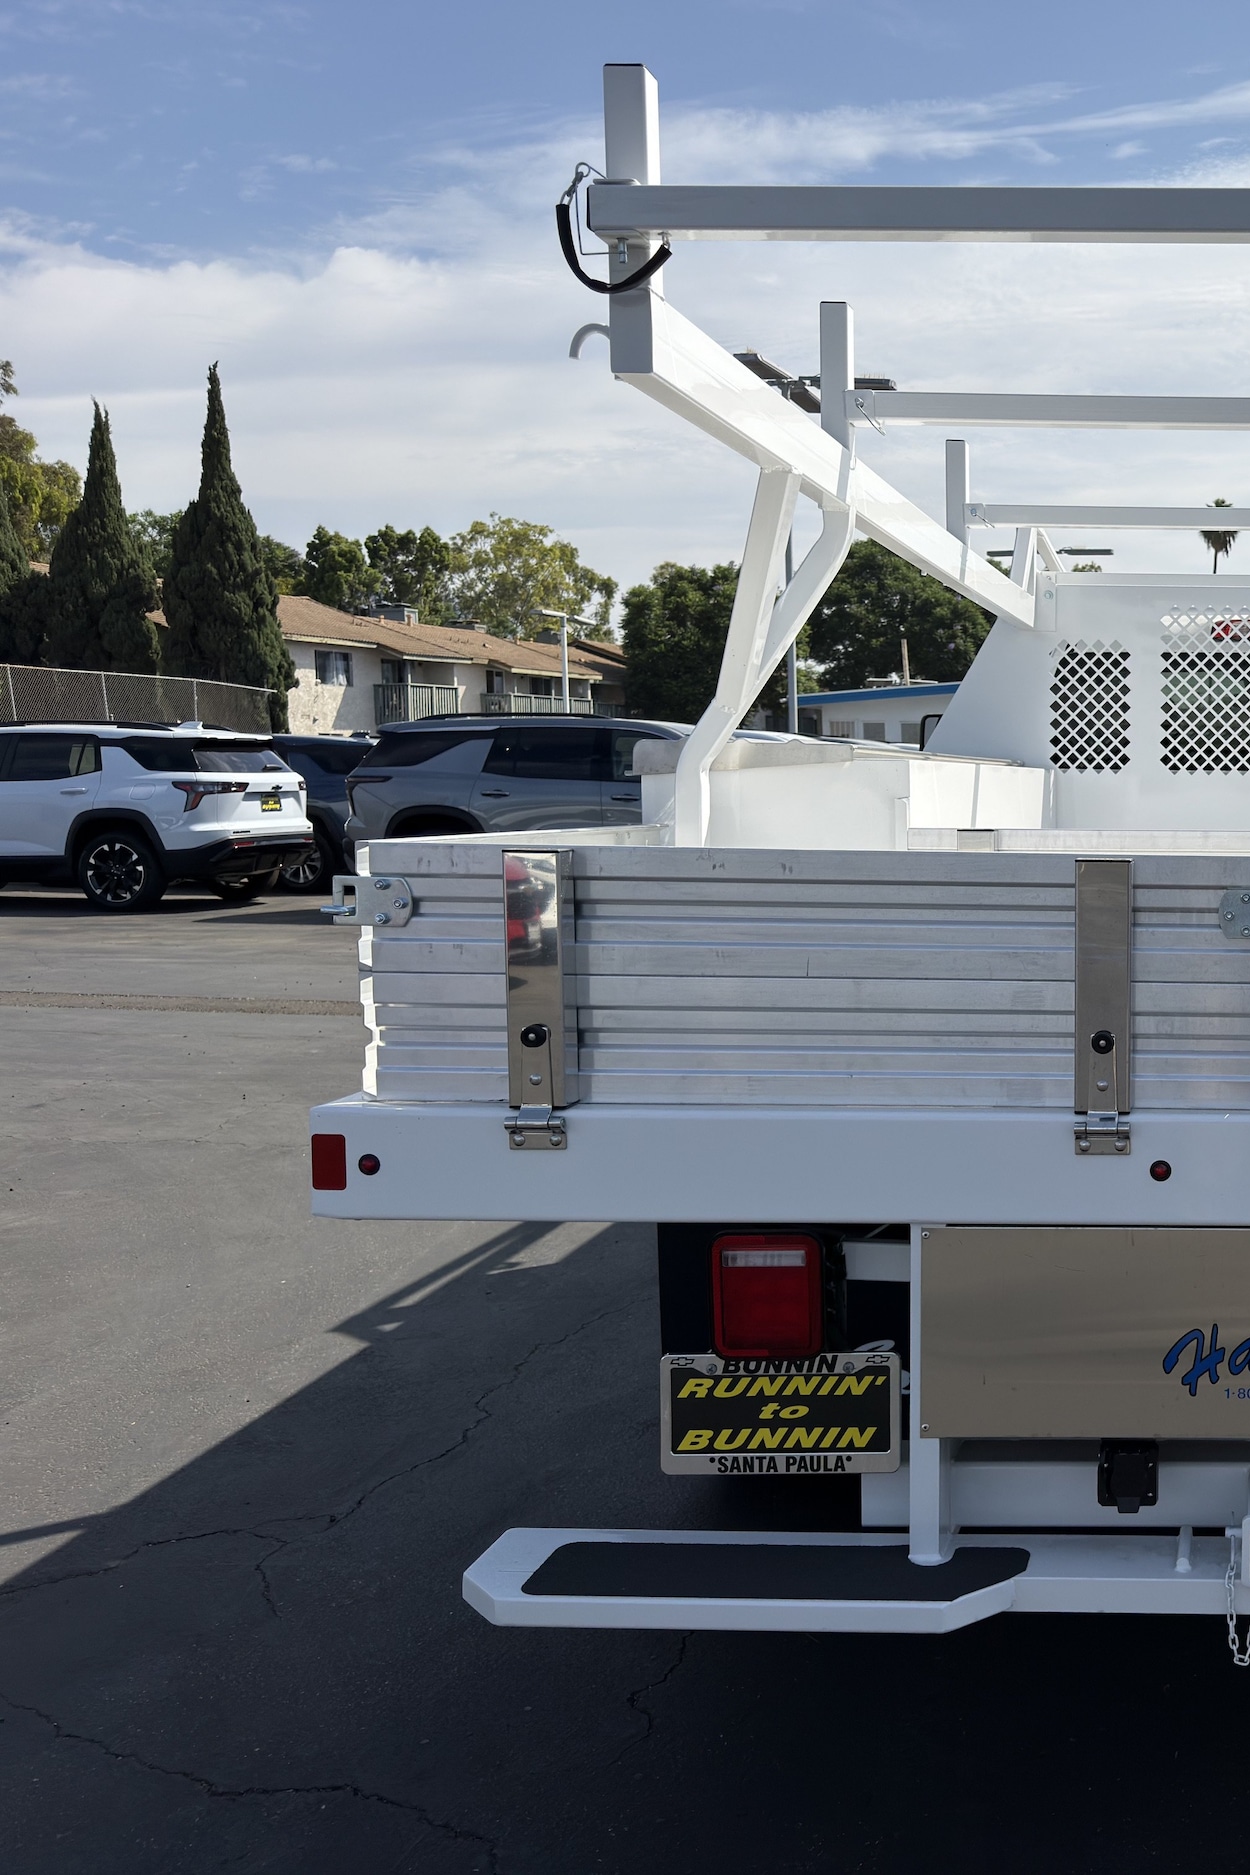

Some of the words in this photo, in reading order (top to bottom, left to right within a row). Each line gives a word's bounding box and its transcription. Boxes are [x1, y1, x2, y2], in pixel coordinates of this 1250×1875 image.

[677, 1375, 887, 1399] RUNNIN'
[758, 1402, 810, 1420] to
[677, 1426, 878, 1451] BUNNIN
